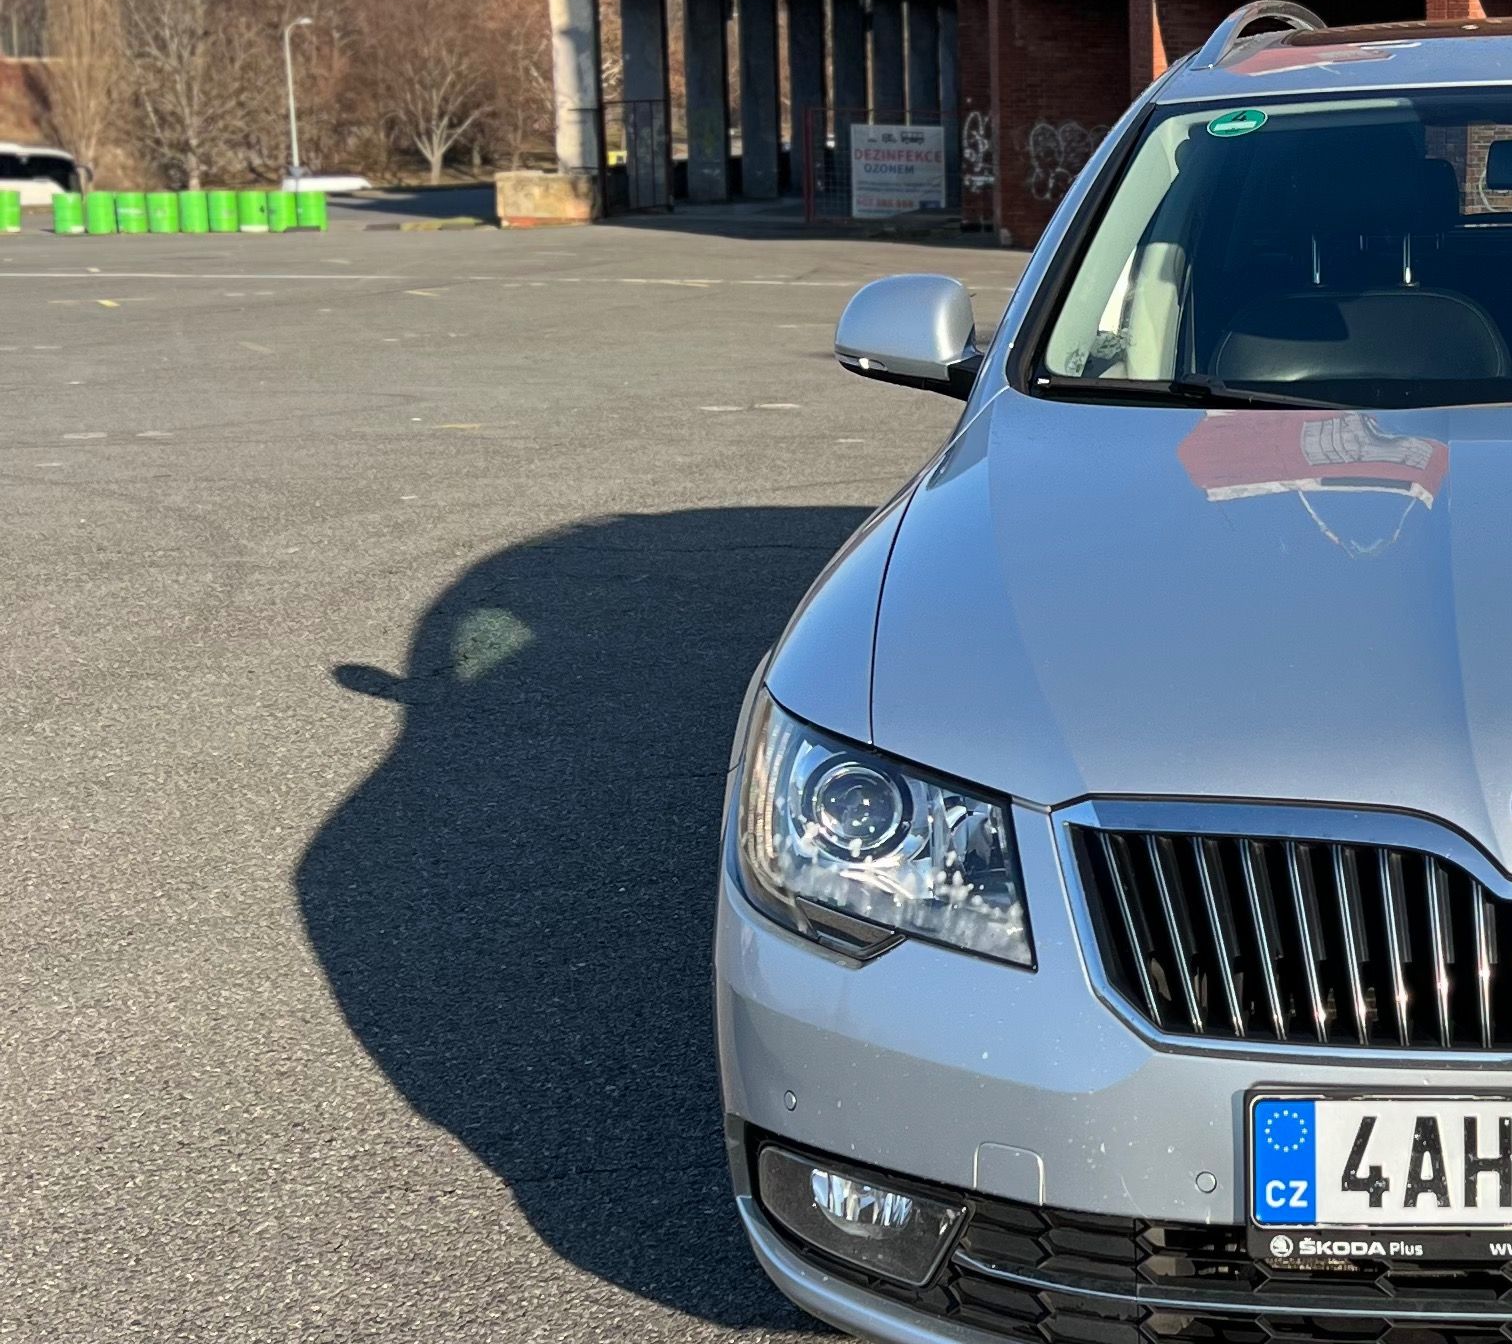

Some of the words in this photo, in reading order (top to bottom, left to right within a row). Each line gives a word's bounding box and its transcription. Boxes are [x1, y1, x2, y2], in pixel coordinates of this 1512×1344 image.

[1231, 109, 1249, 122] 4
[854, 148, 943, 164] DEZINFEKCE
[863, 163, 915, 174] OZONEM
[1340, 1116, 1512, 1208] 4AH
[1265, 1181, 1308, 1208] CZ
[1299, 1237, 1386, 1256] ŠKODA
[1389, 1240, 1424, 1256] Plus
